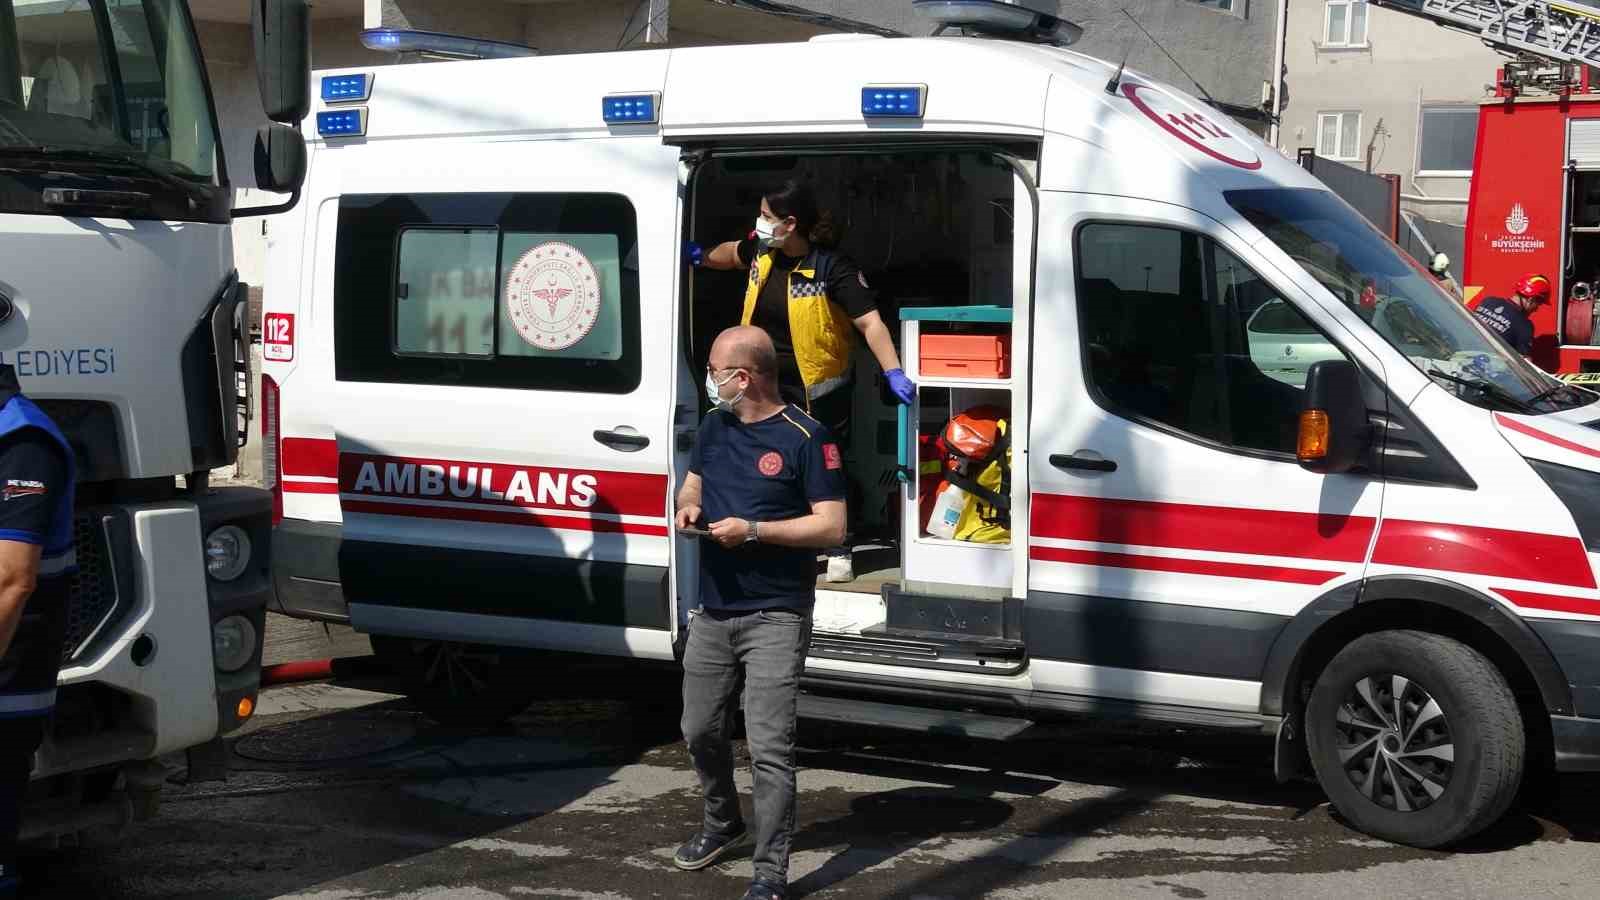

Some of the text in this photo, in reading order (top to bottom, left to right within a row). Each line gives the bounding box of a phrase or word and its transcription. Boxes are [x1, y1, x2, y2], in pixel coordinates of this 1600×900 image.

[1167, 112, 1232, 140] 112
[267, 317, 290, 341] 112
[353, 461, 597, 507] AMBULANS
